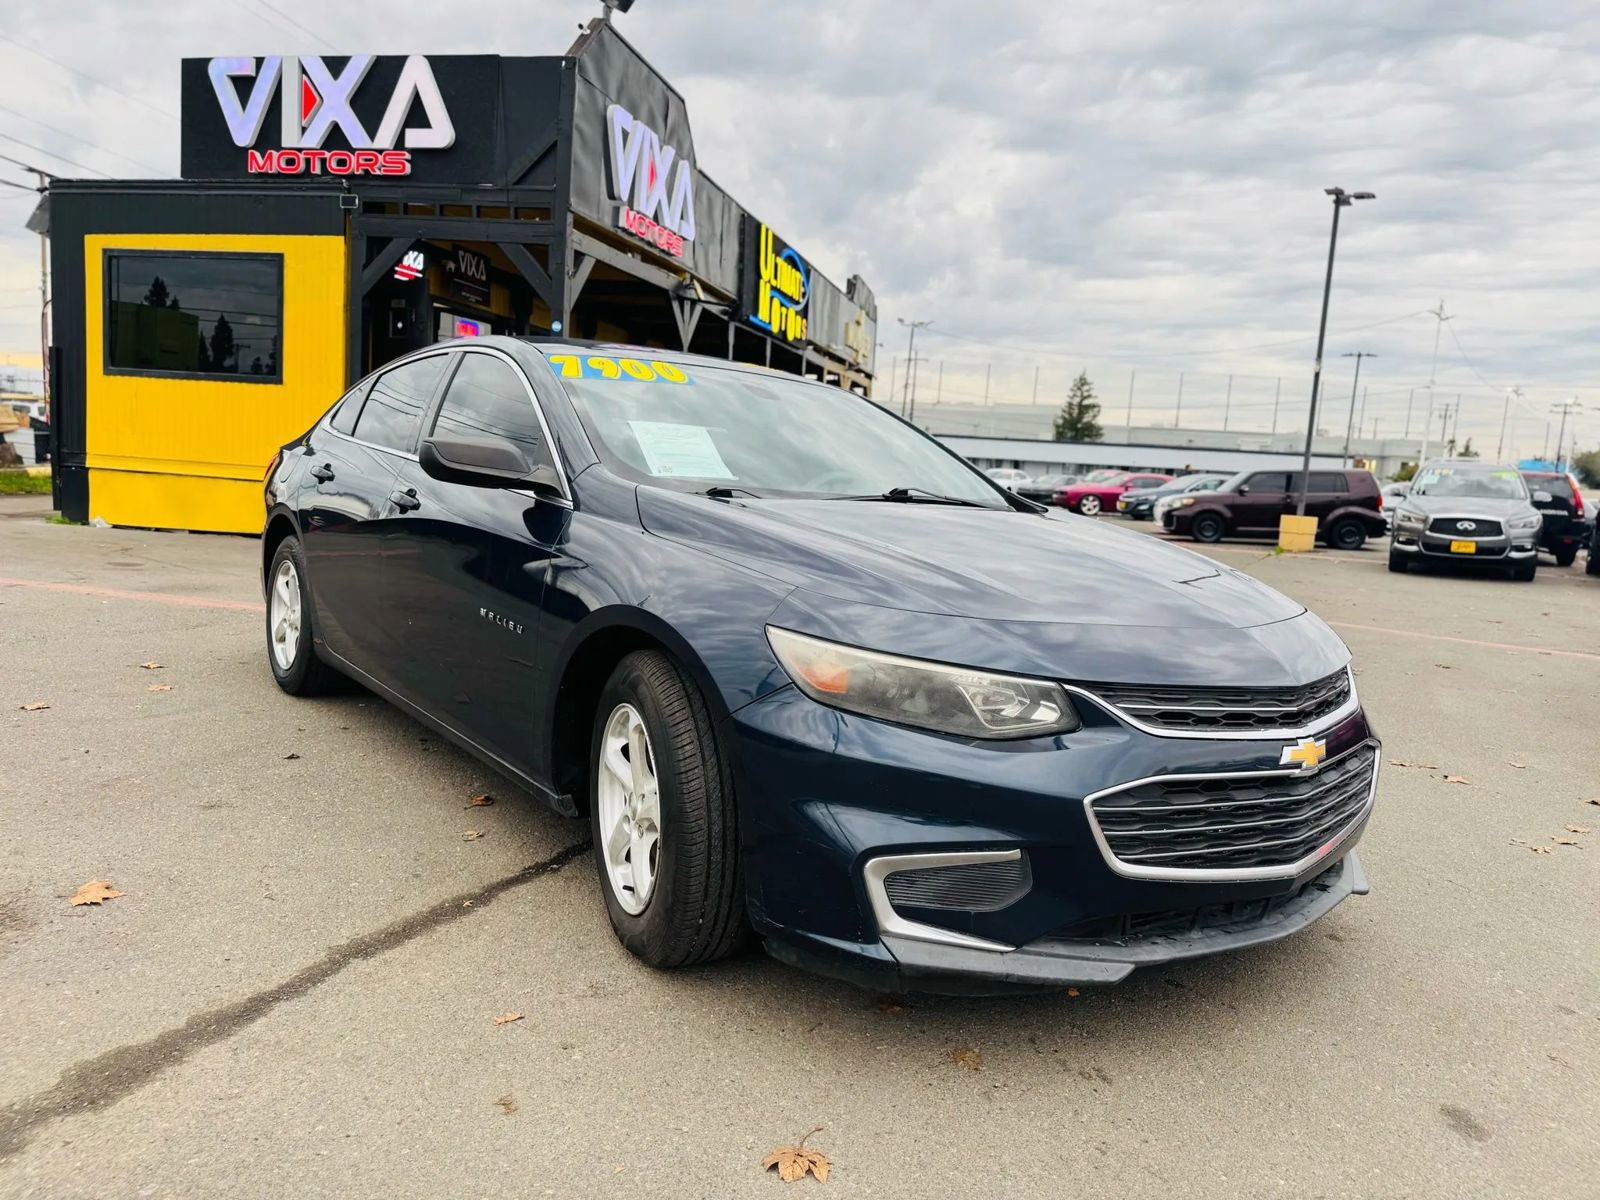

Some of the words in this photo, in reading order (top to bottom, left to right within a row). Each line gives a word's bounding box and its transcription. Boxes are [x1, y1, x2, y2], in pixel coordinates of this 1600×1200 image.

[208, 55, 456, 149] VIXA
[248, 149, 411, 175] MOTORS
[607, 104, 695, 241] VIXA
[612, 206, 684, 258] MOTORS
[458, 250, 487, 281] VIXA
[758, 279, 808, 341] MOTORS
[549, 354, 689, 384] 7900
